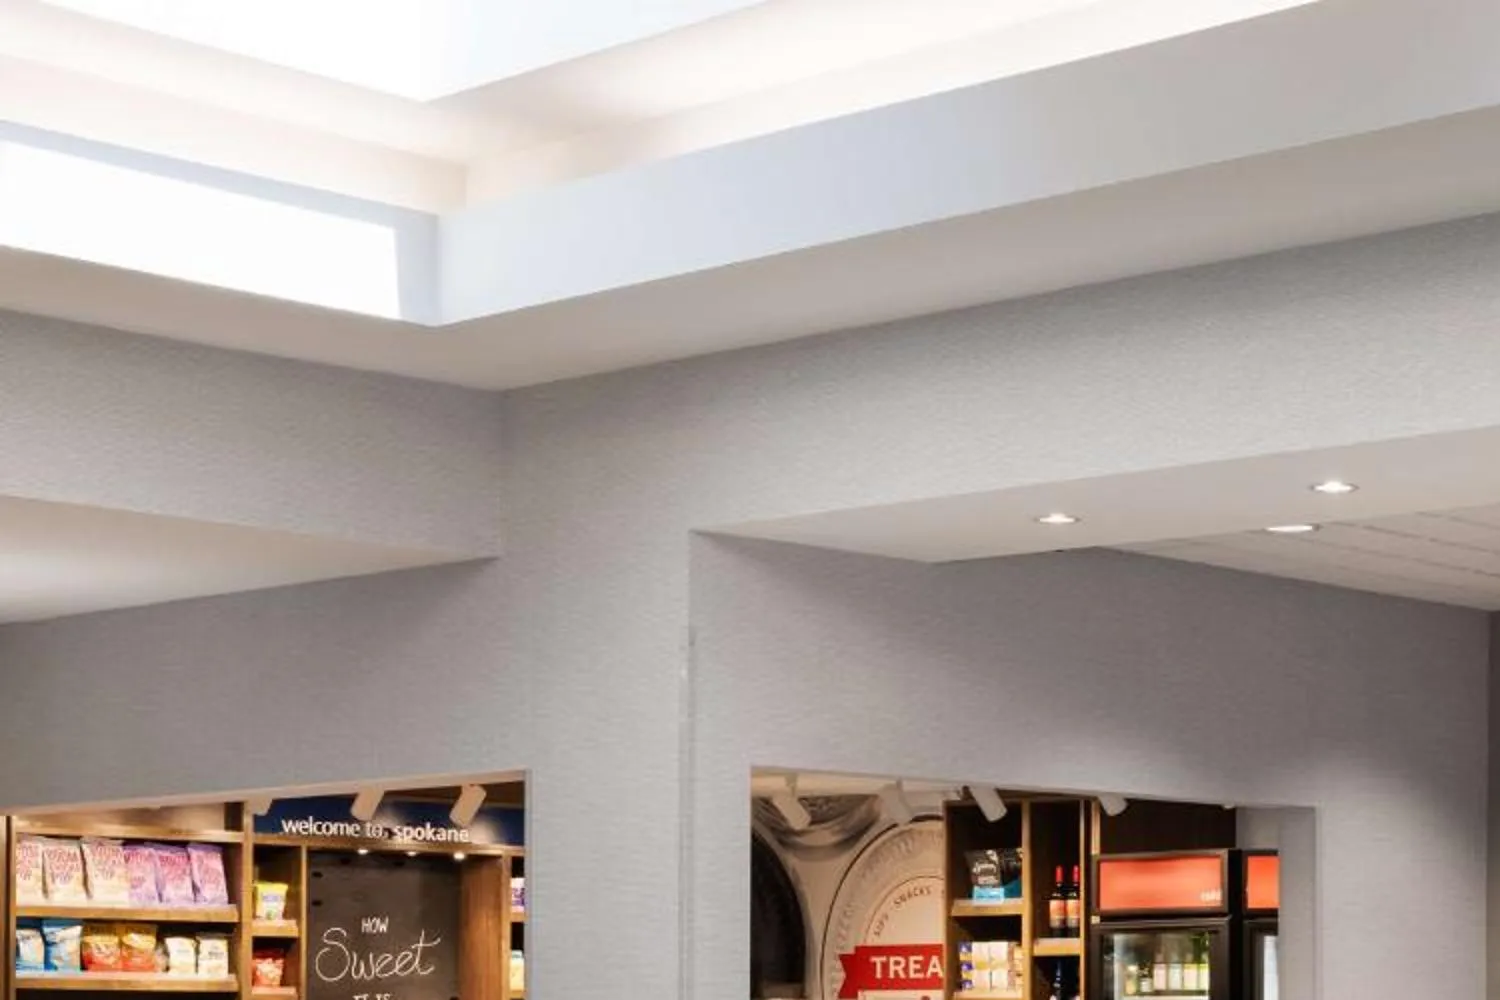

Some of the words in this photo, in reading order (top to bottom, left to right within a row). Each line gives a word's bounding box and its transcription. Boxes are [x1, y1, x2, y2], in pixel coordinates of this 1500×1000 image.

[281, 816, 360, 837] welcome
[394, 822, 470, 843] spokane
[361, 916, 389, 933] HOW
[315, 927, 441, 981] Sweet
[870, 955, 944, 979] TREA
